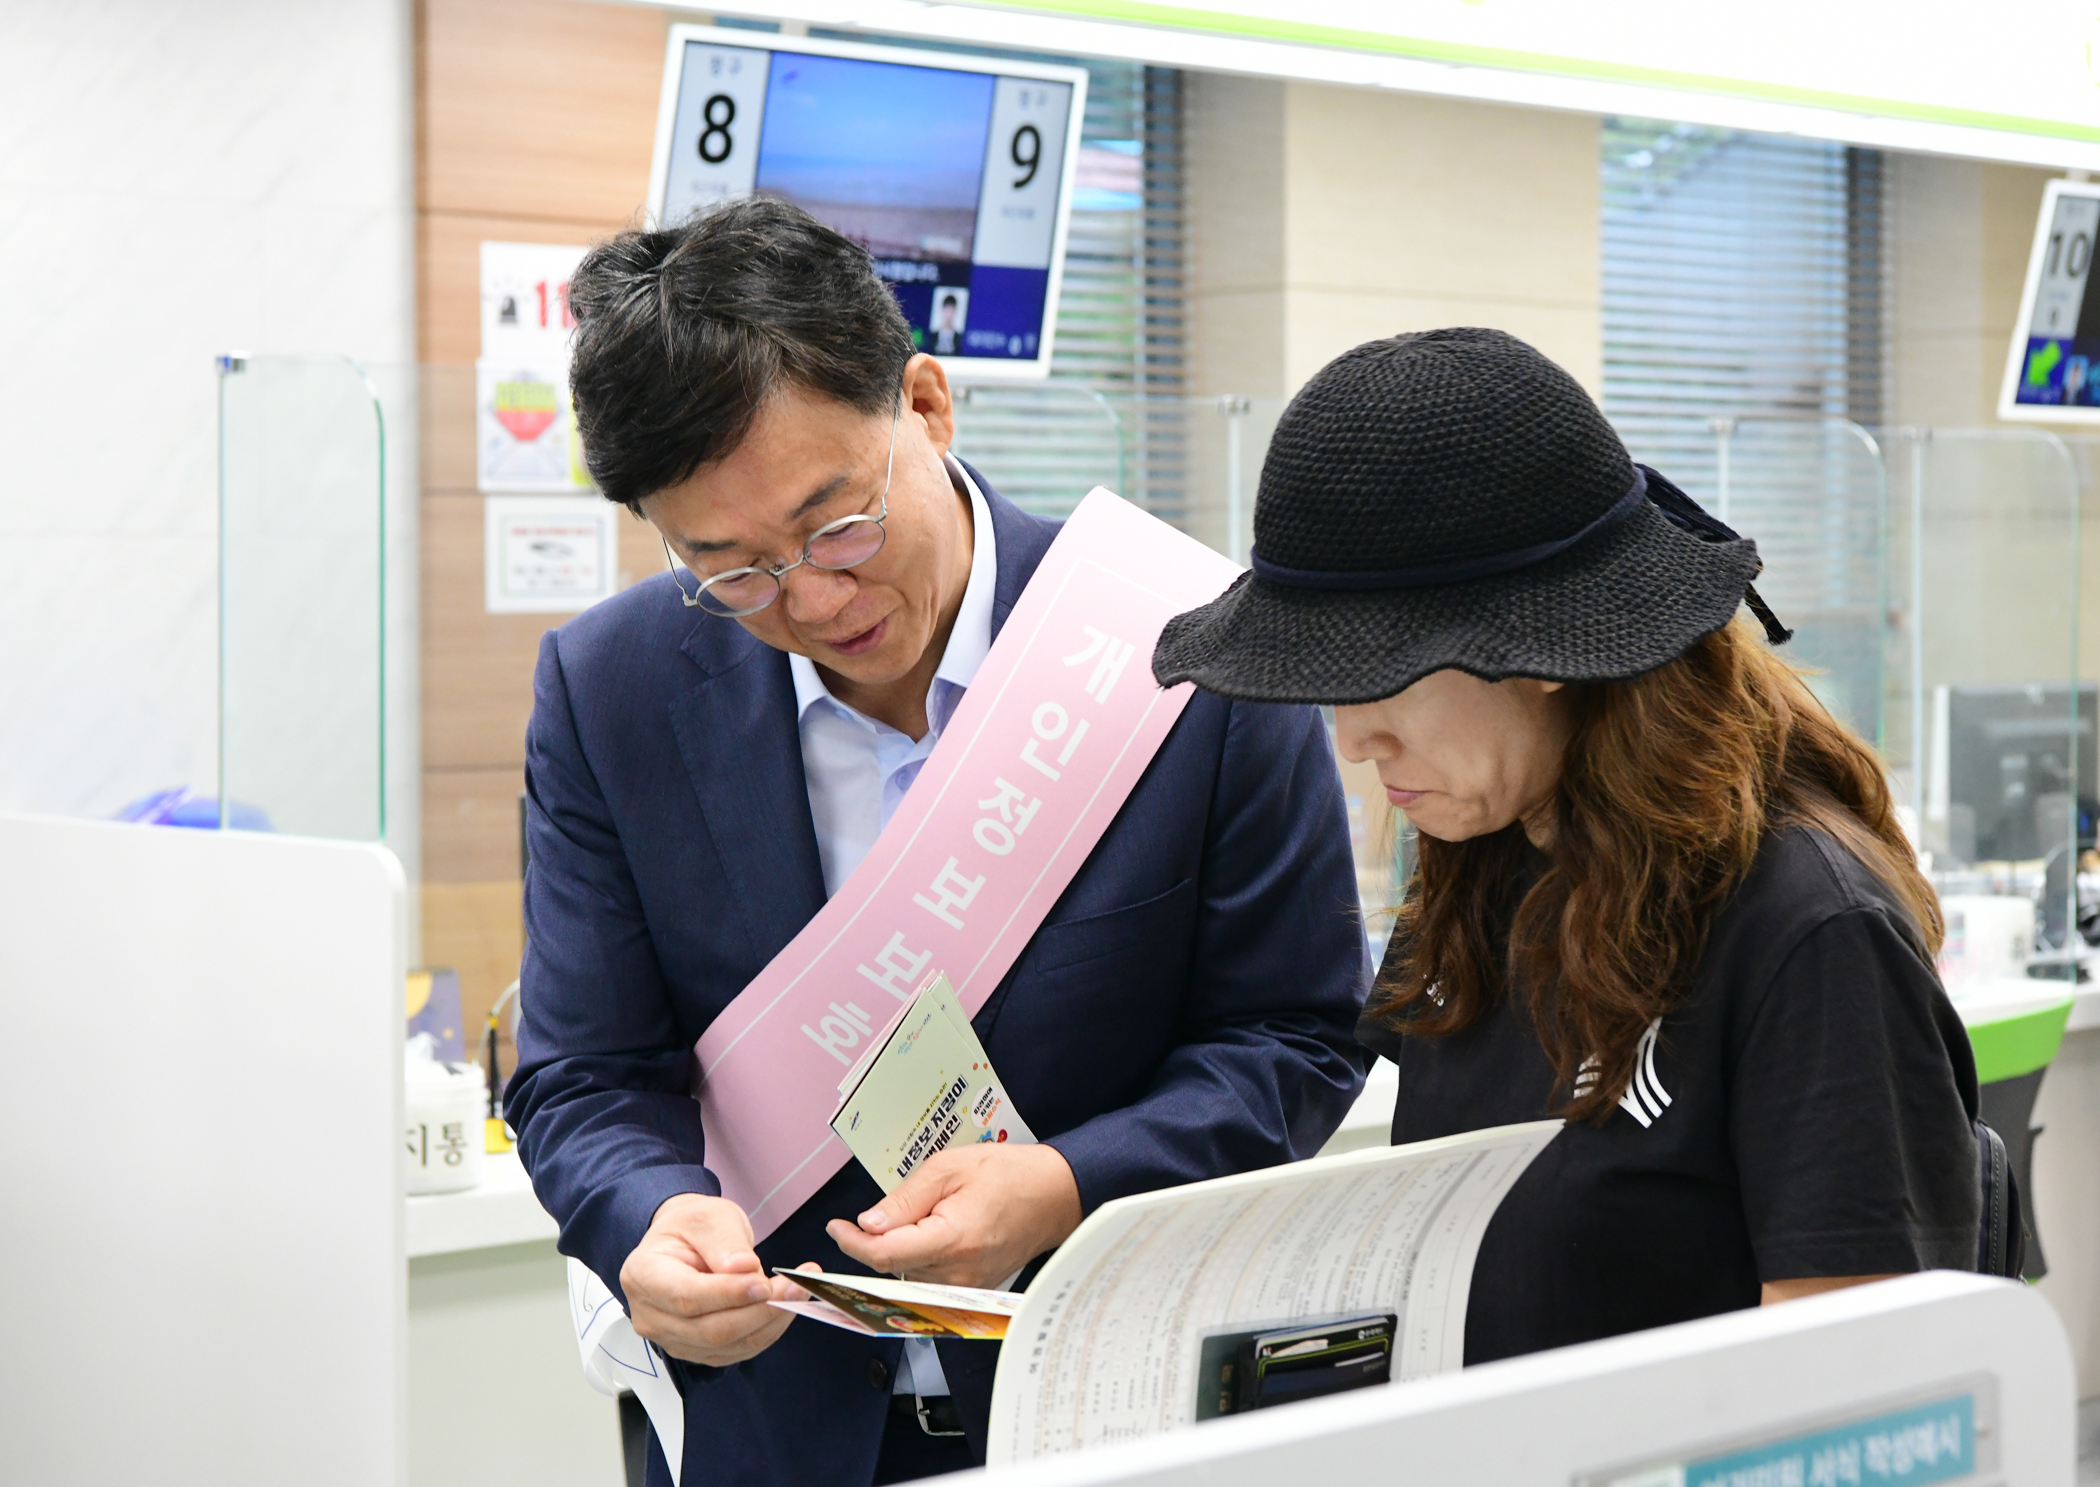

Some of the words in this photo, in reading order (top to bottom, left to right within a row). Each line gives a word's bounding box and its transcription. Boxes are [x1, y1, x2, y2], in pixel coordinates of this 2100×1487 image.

[698, 94, 737, 164] 8
[1011, 124, 1041, 189] 9
[2048, 232, 2089, 279] 10
[931, 1077, 967, 1129] 지킴이
